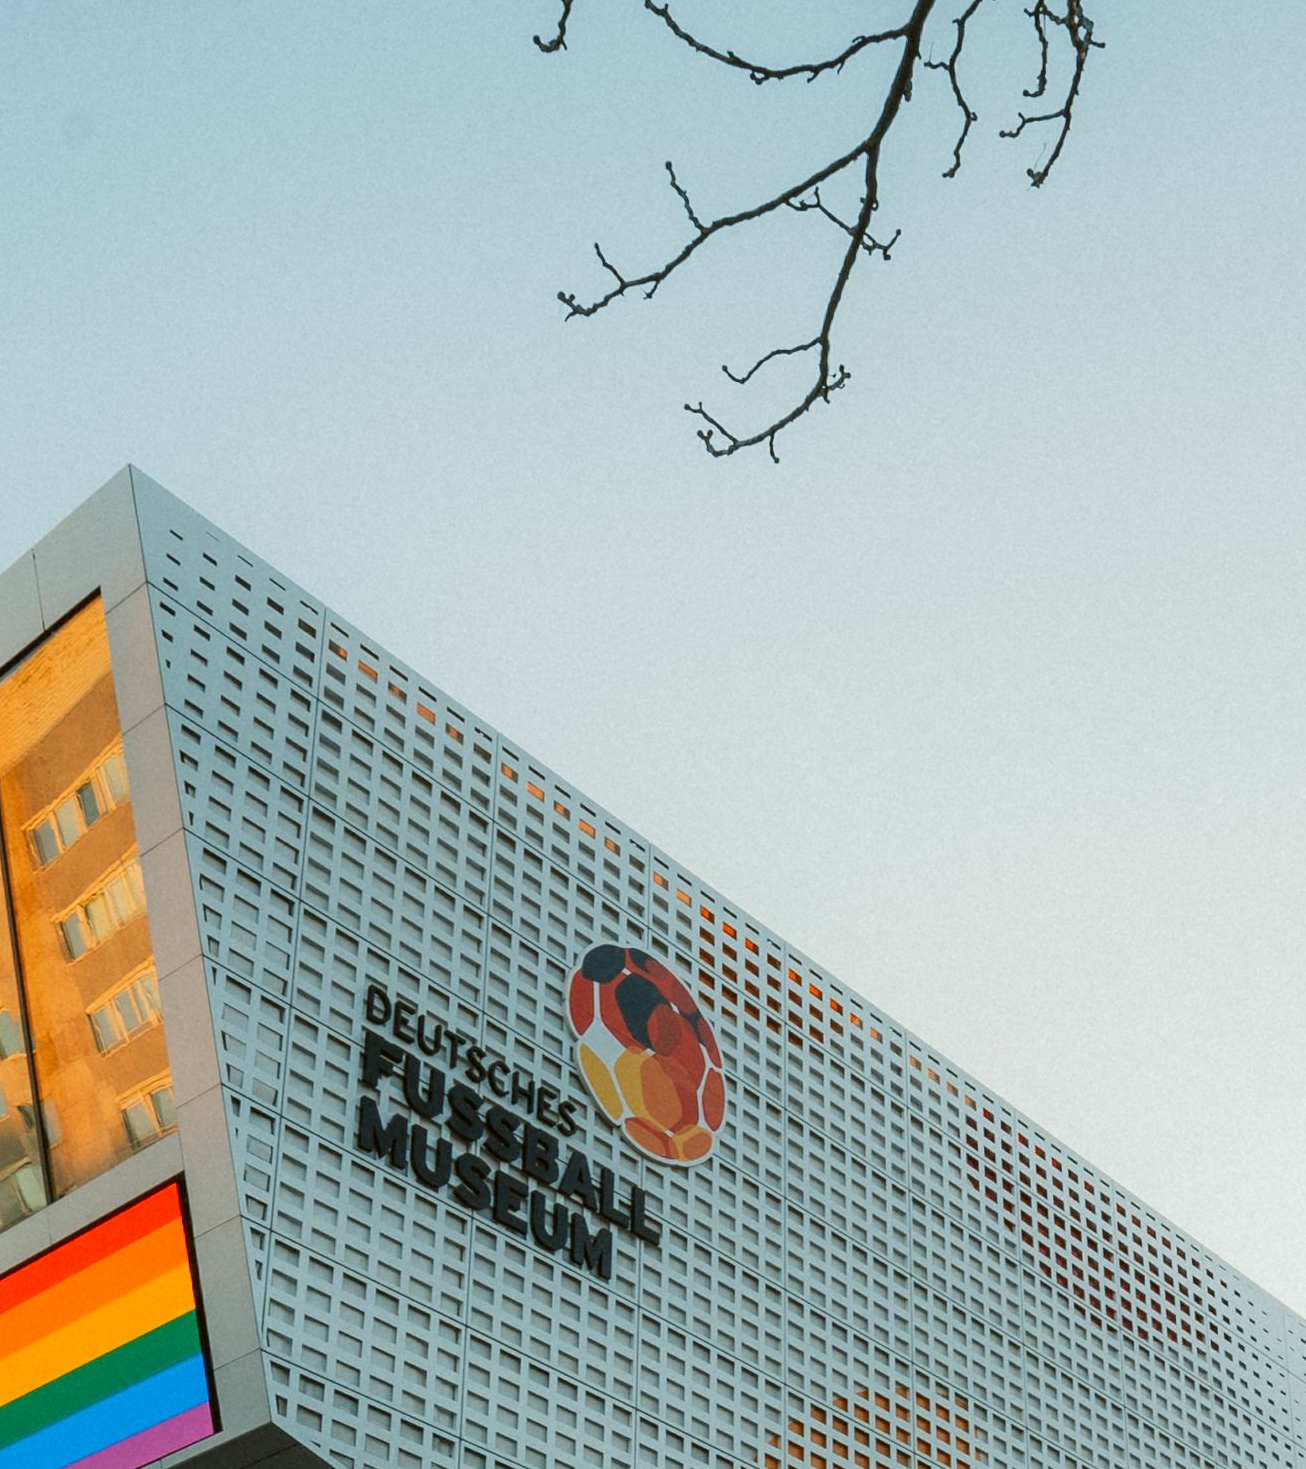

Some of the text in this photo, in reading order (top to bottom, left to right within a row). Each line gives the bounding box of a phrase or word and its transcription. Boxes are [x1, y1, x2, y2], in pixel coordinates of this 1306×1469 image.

[361, 1031, 662, 1247] FUSSBALL
[365, 983, 578, 1137] DEUTSCHES
[356, 1094, 613, 1282] MUSEUM
